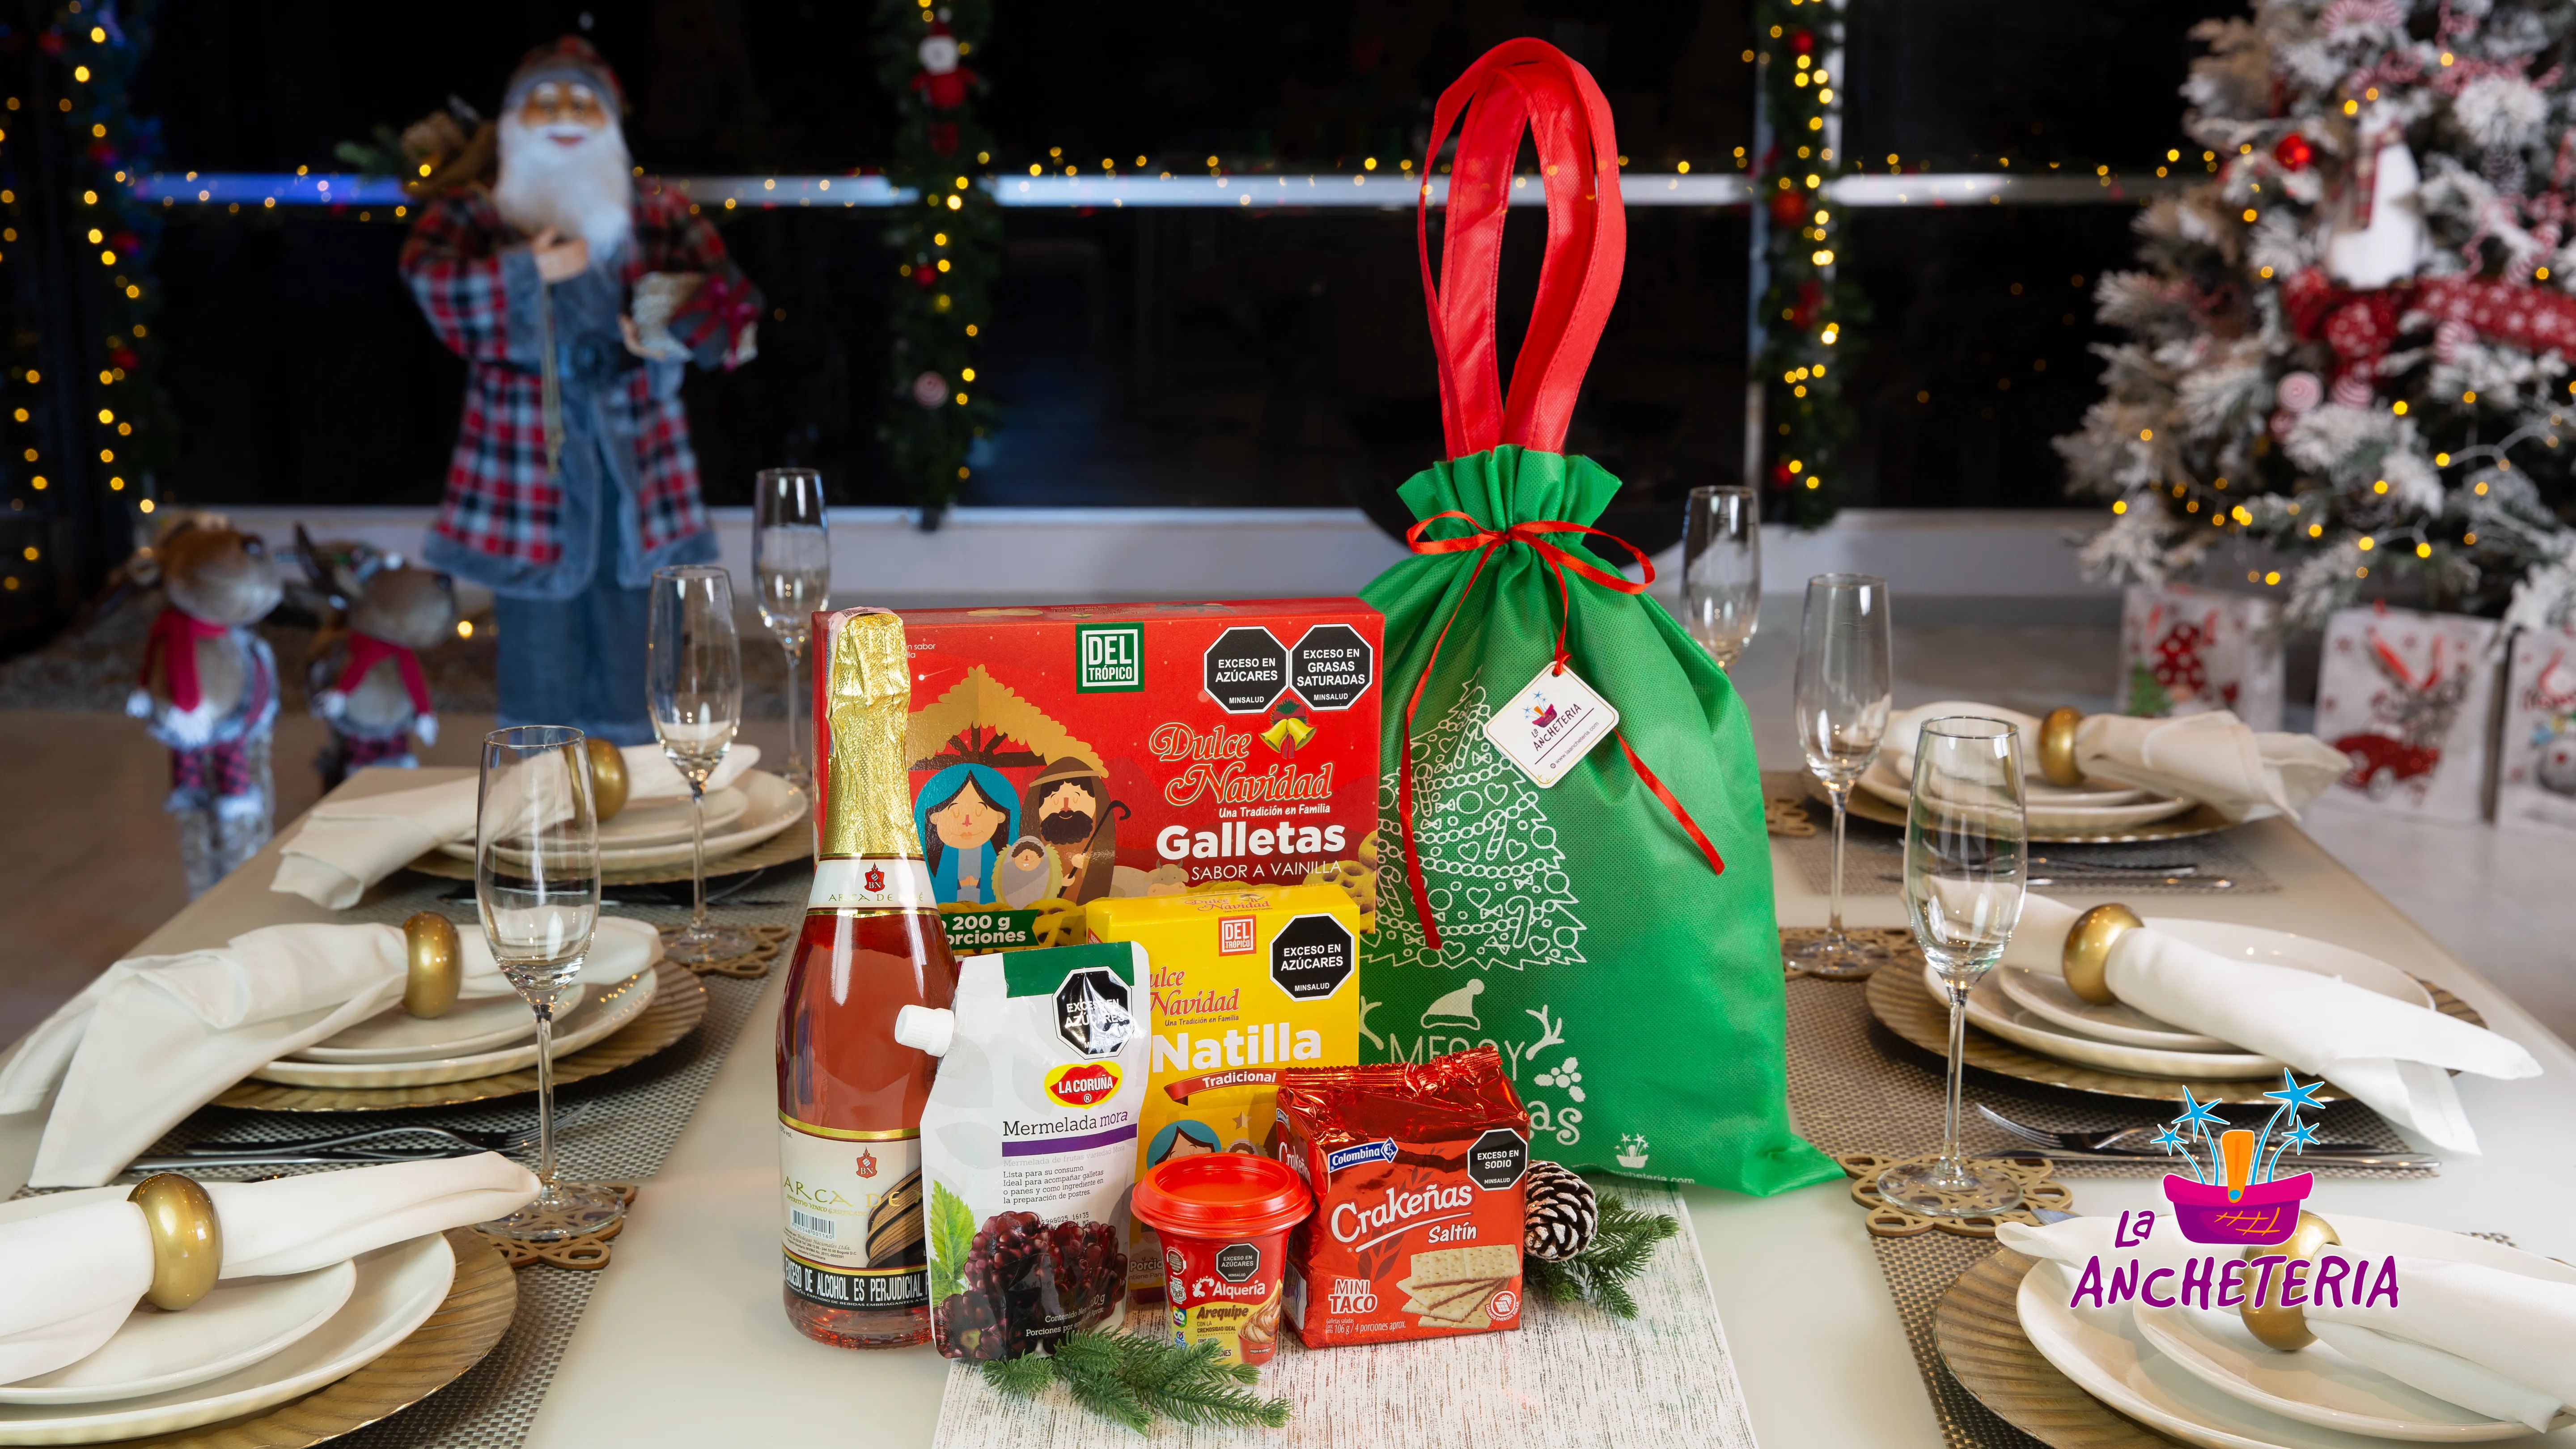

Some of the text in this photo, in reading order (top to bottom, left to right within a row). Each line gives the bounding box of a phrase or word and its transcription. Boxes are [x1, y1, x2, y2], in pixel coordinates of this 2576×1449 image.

[1088, 636, 1132, 665] DEL
[1304, 648, 1360, 659] EXCESO EN
[1218, 658, 1275, 668] EXCESO EN
[1308, 661, 1355, 673] GRASAS
[1089, 665, 1132, 680] TRÓPICO
[1215, 669, 1278, 682] AZÚCARES
[1297, 674, 1365, 686] SATURADAS
[1229, 696, 1264, 704] MINSALUD
[1531, 729, 1538, 738] La
[1533, 703, 1582, 751] ANCHETERIA
[1149, 722, 1252, 761] Dulce
[1555, 721, 1599, 764] www.laancheteria.com
[1165, 761, 1335, 806] Navidad
[1219, 808, 1237, 818] Una
[1240, 805, 1283, 817] Tradición
[1299, 804, 1330, 815] Familia
[1157, 821, 1345, 860] Galletas
[1191, 860, 1341, 880] SABOR A VAINILLA
[828, 894, 870, 902] ARCA
[877, 894, 893, 902] DE
[1197, 901, 1271, 911] Navidad
[953, 915, 992, 930] 200
[998, 917, 1010, 931] g
[946, 930, 1026, 945] orciones
[1225, 923, 1250, 940] DEL
[1284, 944, 1341, 957] EXCESO EN
[1281, 955, 1343, 971] AZÚCARES
[1150, 966, 1185, 989] ulce
[1295, 983, 1330, 992] MINSALUD
[1067, 999, 1119, 1013] EXCESO EN
[1150, 987, 1240, 1017] Navidad
[1065, 1012, 1125, 1028] AZÚCARES
[1152, 1022, 1322, 1073] Natilla
[1058, 1074, 1113, 1094] LA CORUÑA
[1202, 1071, 1277, 1088] Tradicional
[1003, 1111, 1128, 1136] Mermelada mora
[1003, 1158, 1050, 1167] Mermelada
[1063, 1155, 1085, 1163] frutas
[1087, 1148, 1112, 1159] variedad
[1113, 1145, 1125, 1153] Mora
[1332, 1147, 1380, 1166] Colombina
[1477, 1149, 1519, 1161] EXCESO EN
[1025, 1170, 1042, 1178] para
[1054, 1166, 1085, 1174] consumo.
[1485, 1159, 1512, 1169] SODIO
[1025, 1178, 1042, 1187] para
[1044, 1173, 1081, 1185] acompañar
[1082, 1169, 1104, 1180] galletas
[784, 1176, 853, 1207] ARCA
[865, 1191, 900, 1208] DE
[1011, 1188, 1033, 1196] panes
[1062, 1179, 1096, 1191] ingrediente
[1013, 1194, 1057, 1205] preparación
[1068, 1190, 1091, 1200] postres.
[1331, 1183, 1472, 1243] Crakeñas
[1428, 1221, 1477, 1243] Saltín
[813, 1239, 837, 1249] Nacionales
[1129, 1258, 1163, 1272] Porcio
[785, 1257, 802, 1289] EXCESO
[805, 1268, 813, 1293] DE
[817, 1272, 849, 1301] ALCOHOL
[854, 1278, 865, 1302] ES
[870, 1275, 923, 1302] PERJUDICIAL
[1335, 1280, 1369, 1295] MINI
[1212, 1280, 1265, 1299] Alquería
[807, 1293, 830, 1303] EXPENDIO
[1330, 1295, 1376, 1313] TACO
[1045, 1311, 1077, 1323] Contenido
[1100, 1294, 1106, 1305] g
[1196, 1305, 1249, 1320] Arequipe
[1486, 1304, 1497, 1320] USAMOS
[1026, 1327, 1061, 1337] Porciones
[1063, 1324, 1073, 1333] por
[1335, 1324, 1345, 1334] 106
[1345, 1326, 1350, 1335] g
[1355, 1323, 1359, 1332] 4
[1360, 1321, 1388, 1334] porciones
[1389, 1320, 1407, 1332] aprox.
